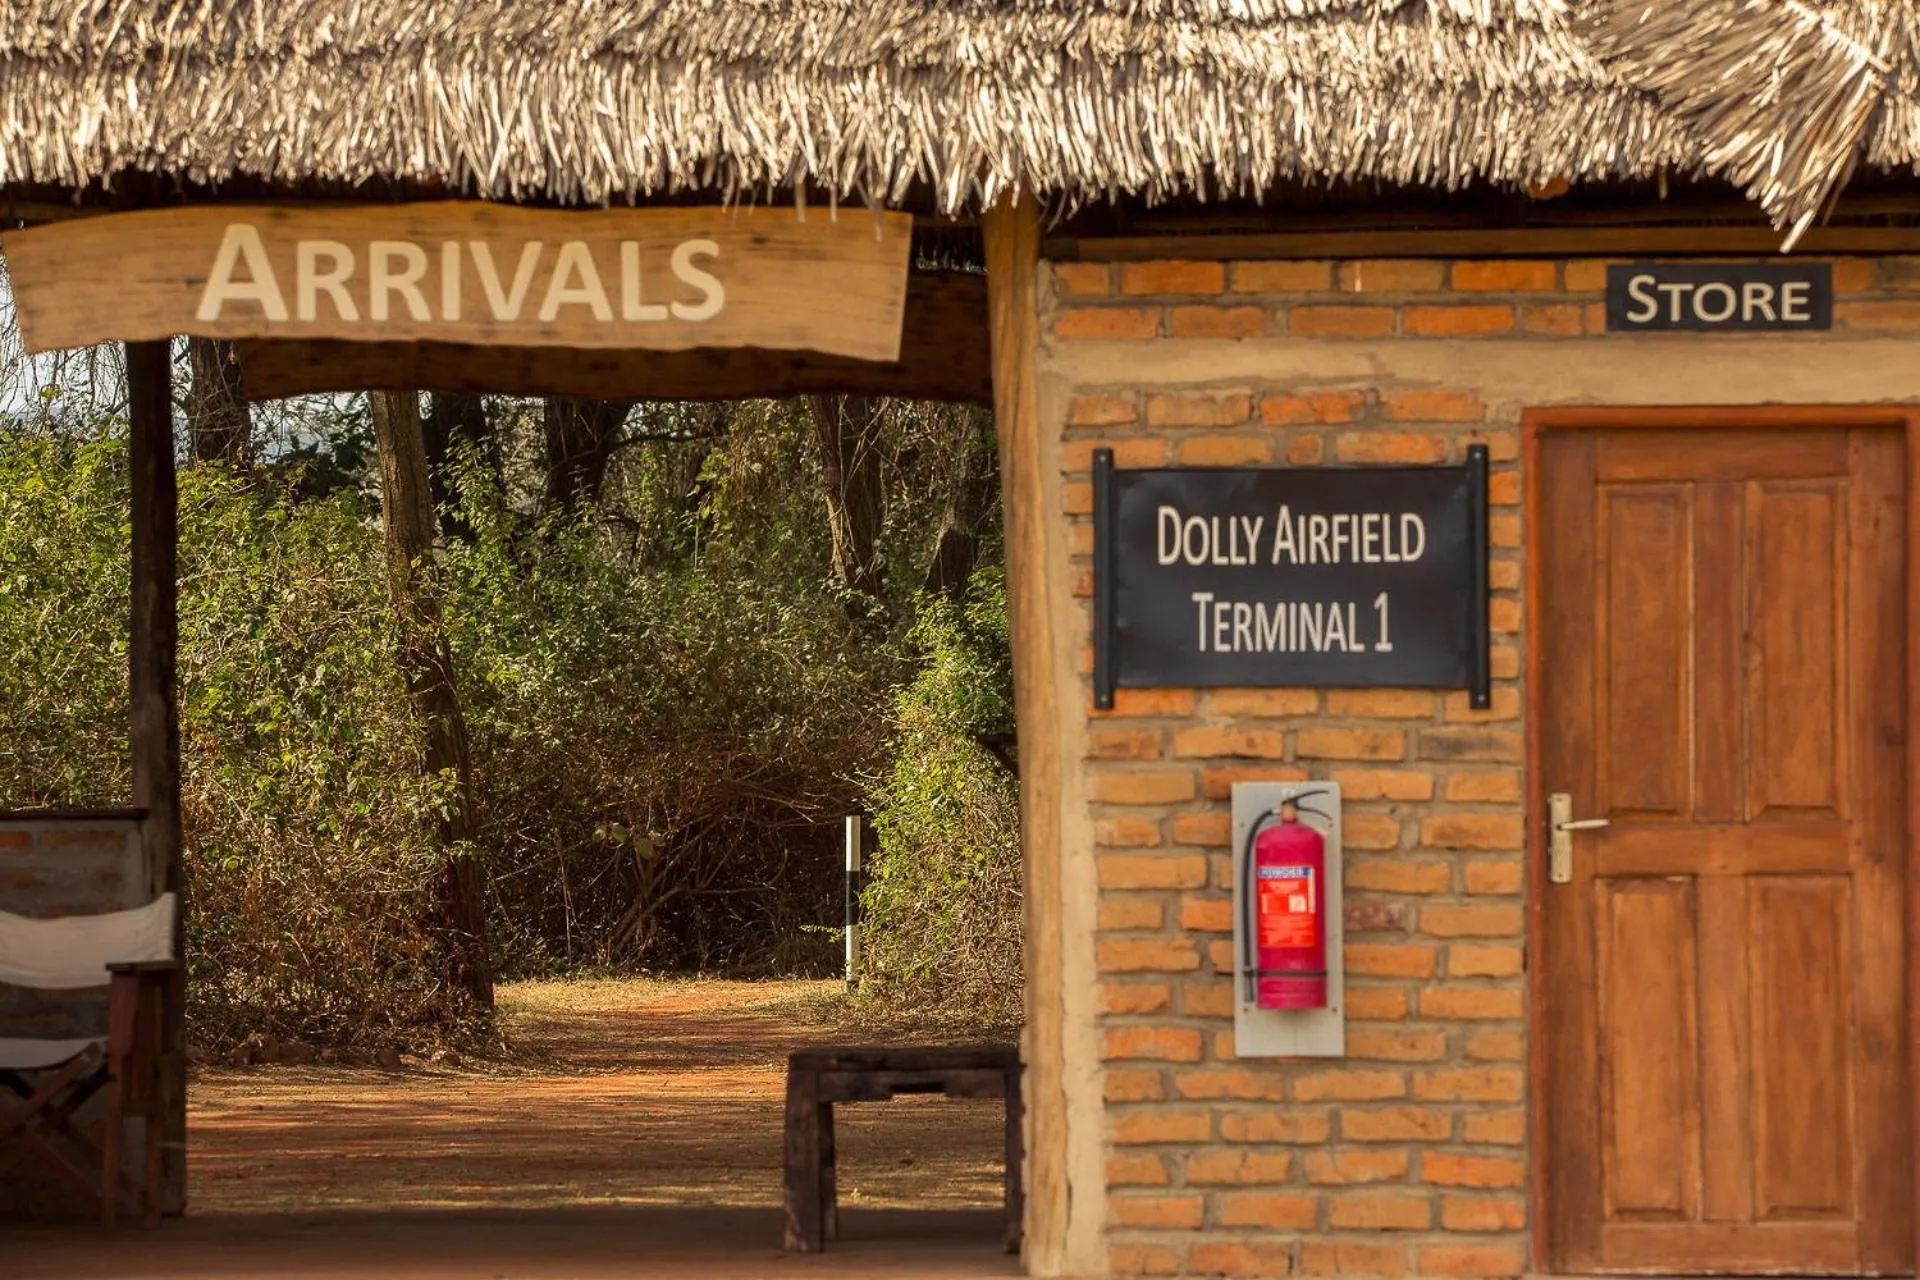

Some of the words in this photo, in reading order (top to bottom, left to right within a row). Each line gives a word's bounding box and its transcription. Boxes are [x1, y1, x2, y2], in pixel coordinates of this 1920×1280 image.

[197, 222, 726, 322] ARRIVALS
[1626, 274, 1811, 323] STORE
[1157, 505, 1264, 567] DOLLY
[1271, 504, 1427, 566] AIRFIELD
[1190, 591, 1367, 654] TERMINAL
[1373, 591, 1394, 653] 1
